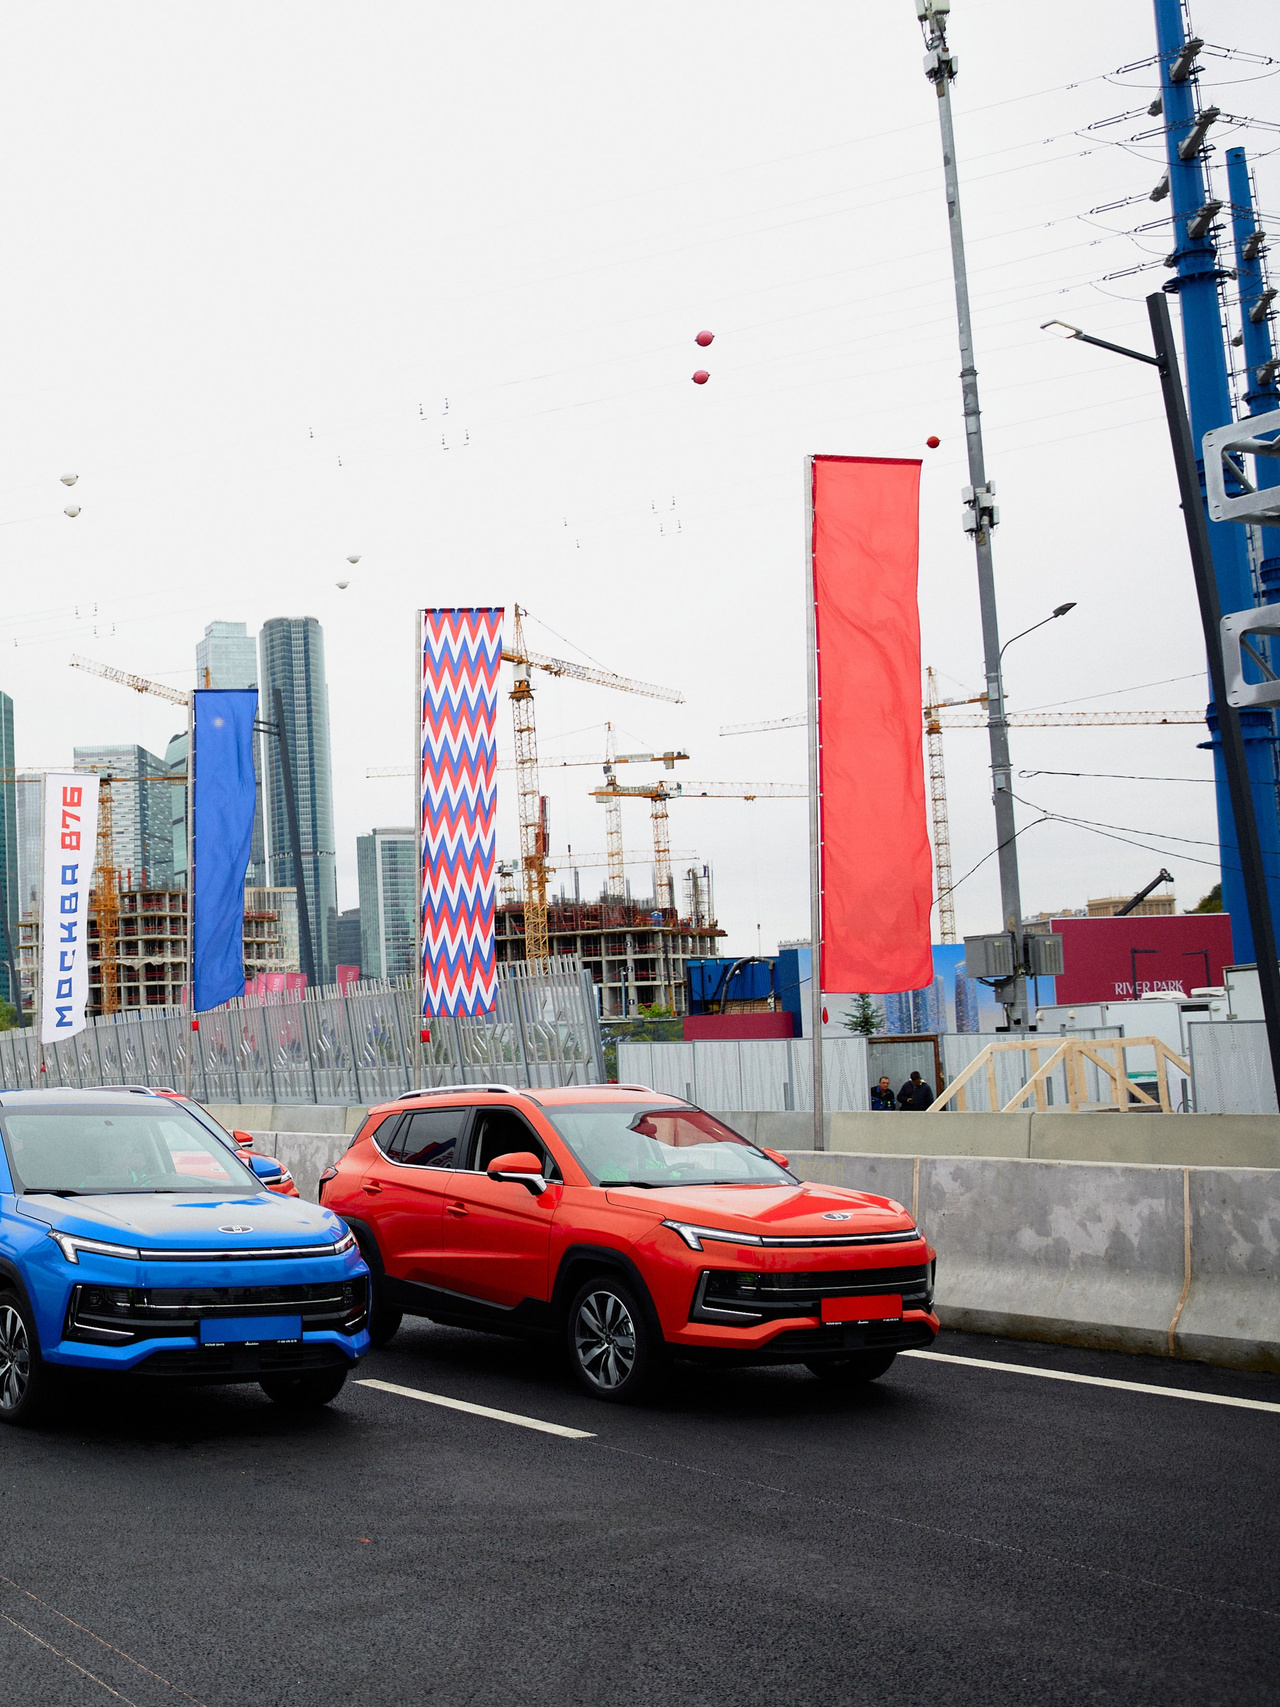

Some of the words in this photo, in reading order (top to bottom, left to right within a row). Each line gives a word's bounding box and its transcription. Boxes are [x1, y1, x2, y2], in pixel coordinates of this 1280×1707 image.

[60, 786, 83, 851] 876
[55, 863, 79, 1028] МОСКВА
[1115, 982, 1150, 995] RIVER
[1153, 981, 1184, 993] PARK
